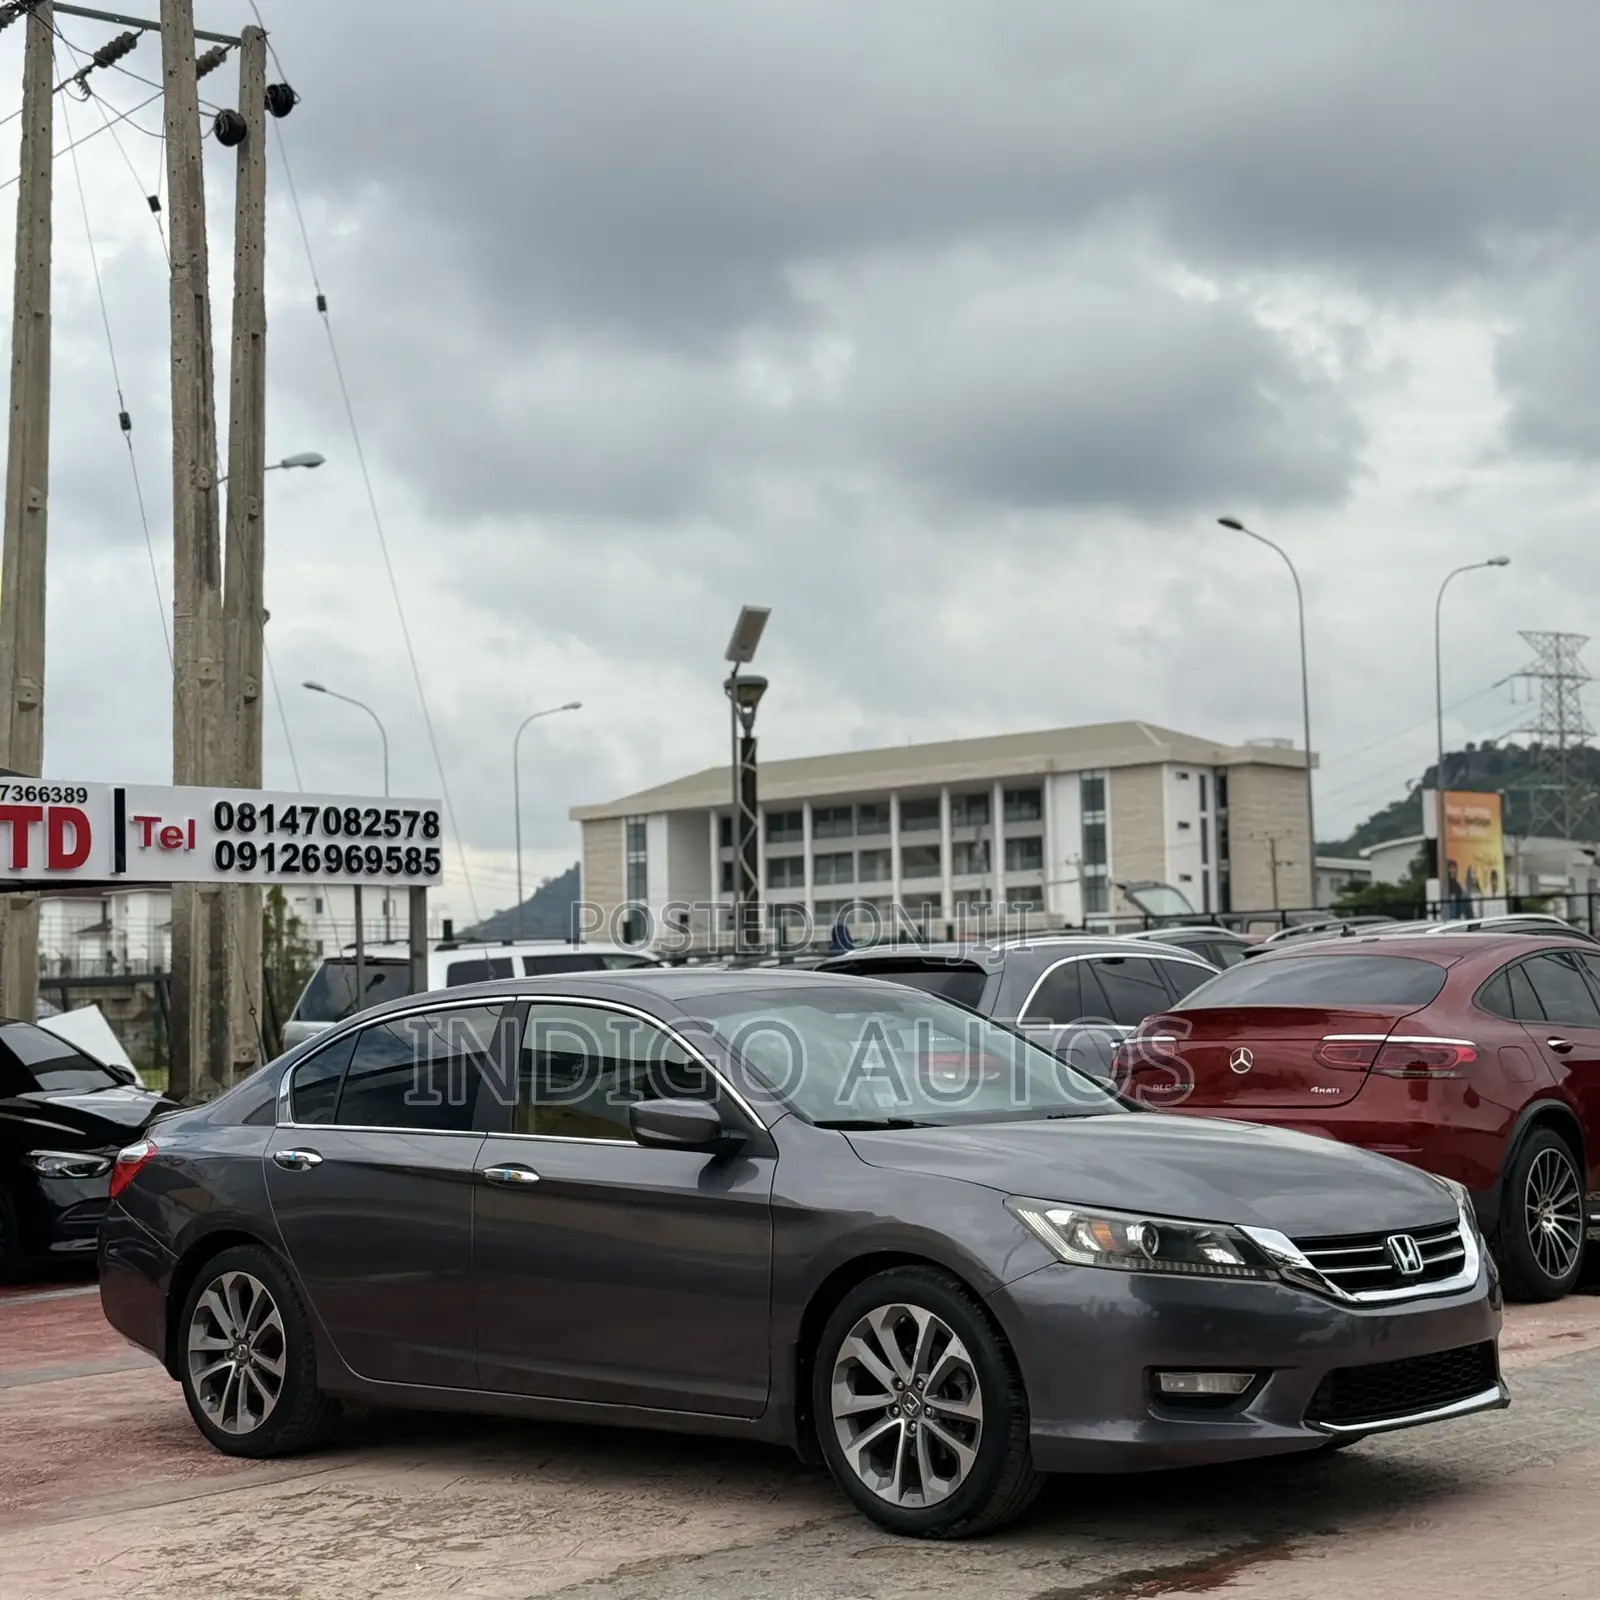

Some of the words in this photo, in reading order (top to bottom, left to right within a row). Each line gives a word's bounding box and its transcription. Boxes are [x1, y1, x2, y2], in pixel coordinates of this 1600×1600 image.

[0, 785, 88, 804] 7366389
[132, 815, 196, 850] Tel
[213, 801, 440, 839] 08147082578
[214, 840, 441, 876] 09126969585
